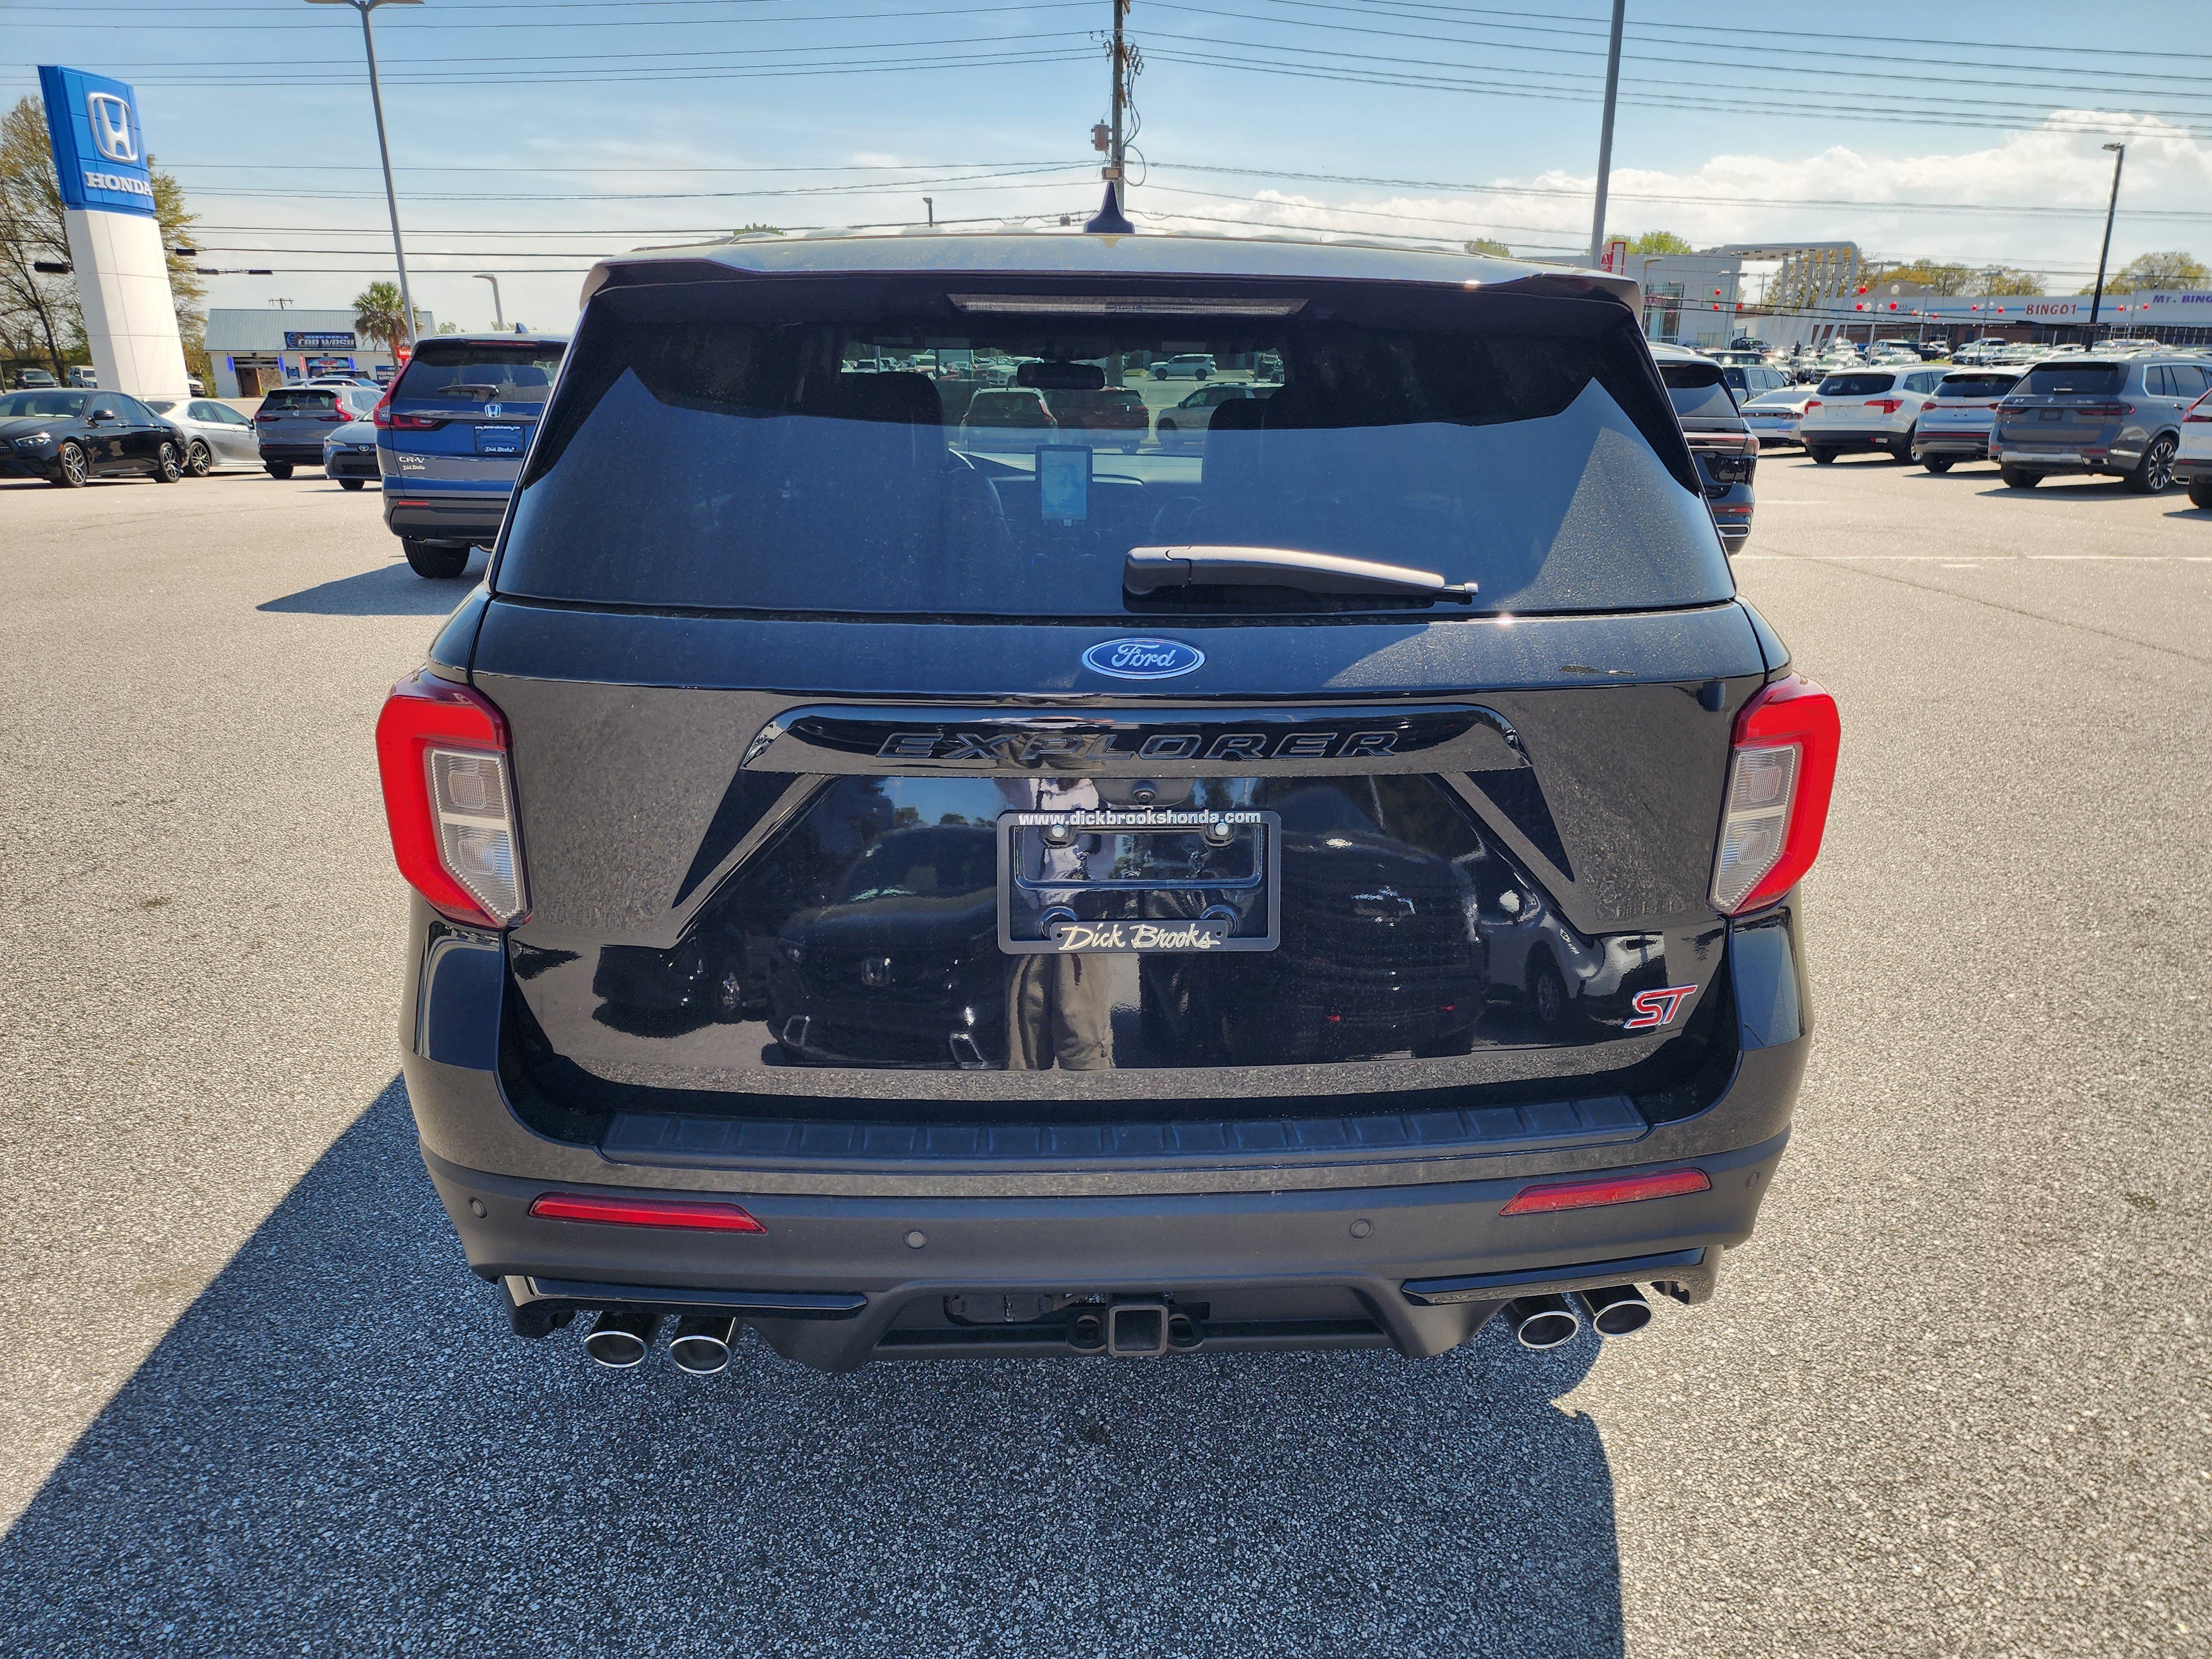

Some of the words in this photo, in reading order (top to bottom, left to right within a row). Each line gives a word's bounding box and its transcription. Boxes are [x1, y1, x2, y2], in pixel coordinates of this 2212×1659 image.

[85, 171, 153, 197] HONDA
[298, 338, 320, 348] CAR
[321, 338, 354, 348] WASH
[1111, 643, 1177, 667] Ford
[874, 731, 1399, 760] EXPLORER
[1018, 809, 1261, 826] www.dickbrookshonda.com
[1057, 923, 1126, 951] Dick
[1129, 923, 1221, 950] Brooks
[1623, 984, 1698, 1030] ST
